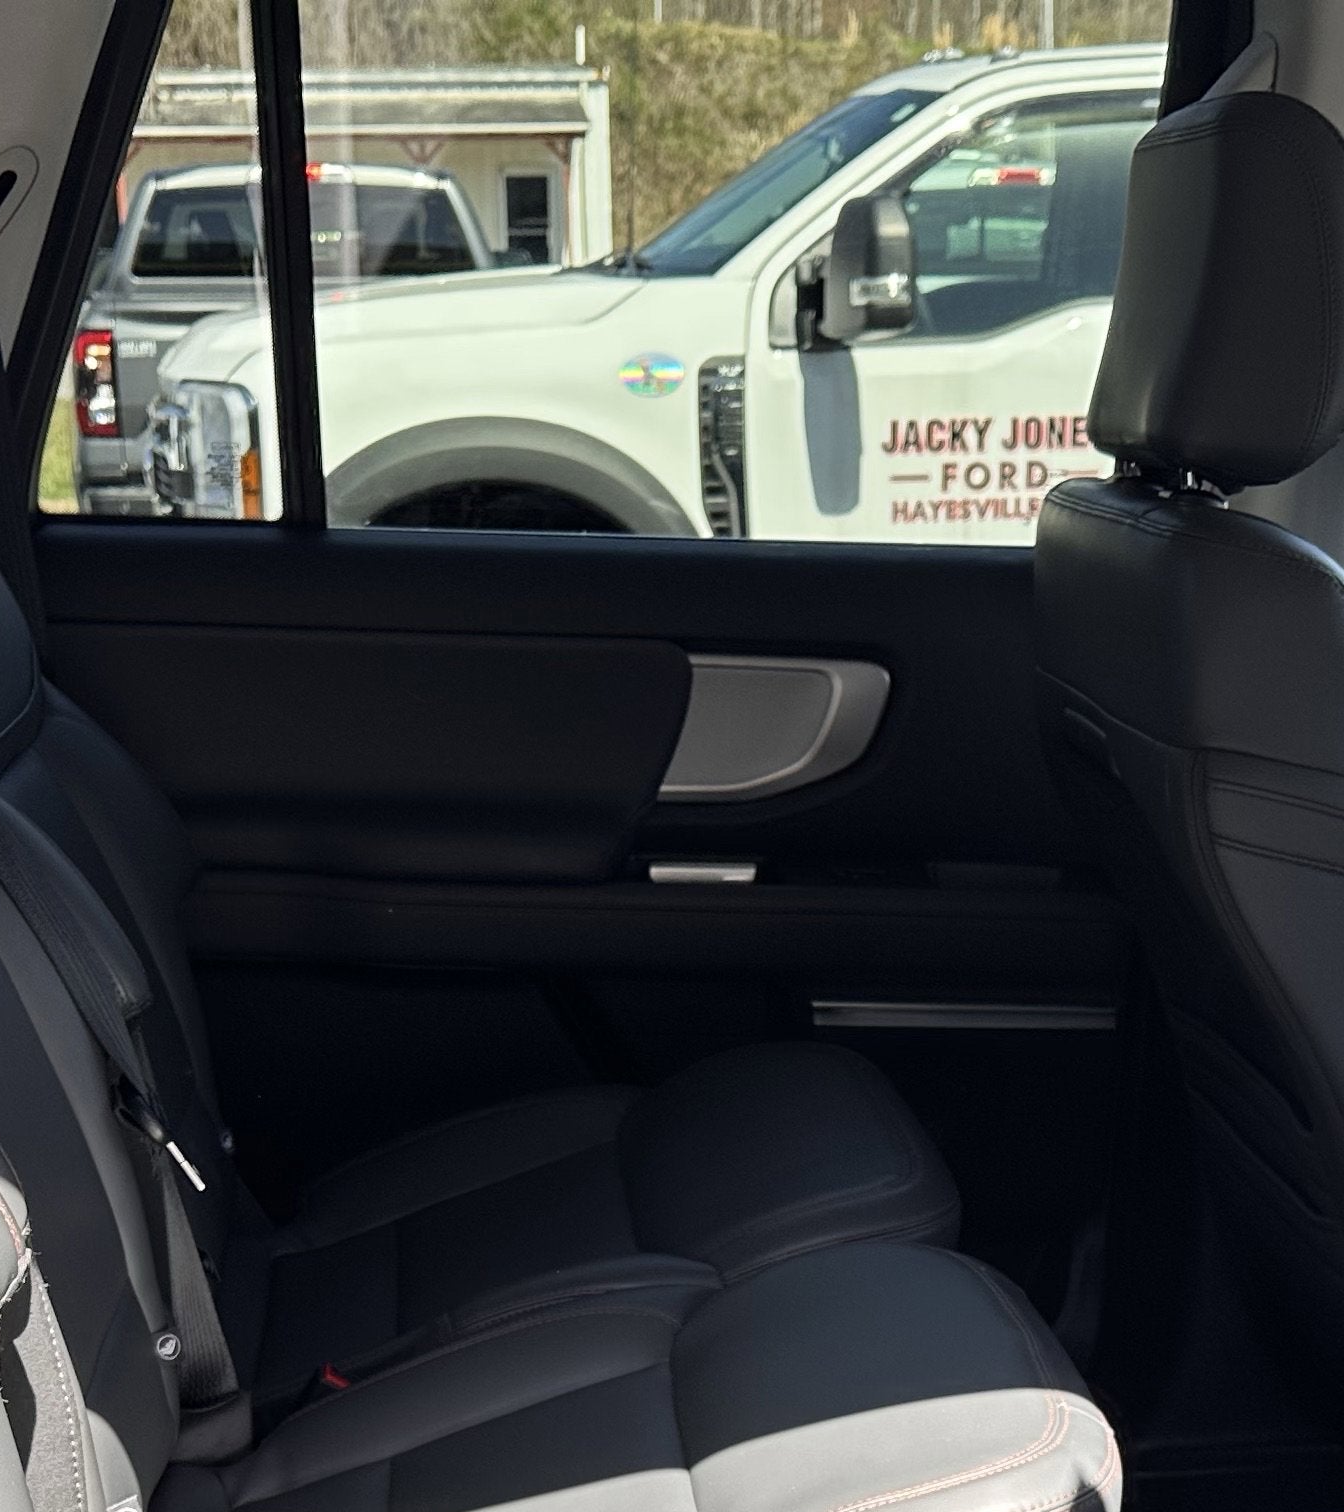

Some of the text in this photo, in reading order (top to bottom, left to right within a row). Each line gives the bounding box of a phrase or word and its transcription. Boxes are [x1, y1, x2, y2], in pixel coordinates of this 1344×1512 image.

[881, 416, 1088, 453] JACKY JONE
[941, 460, 1048, 491] FORD
